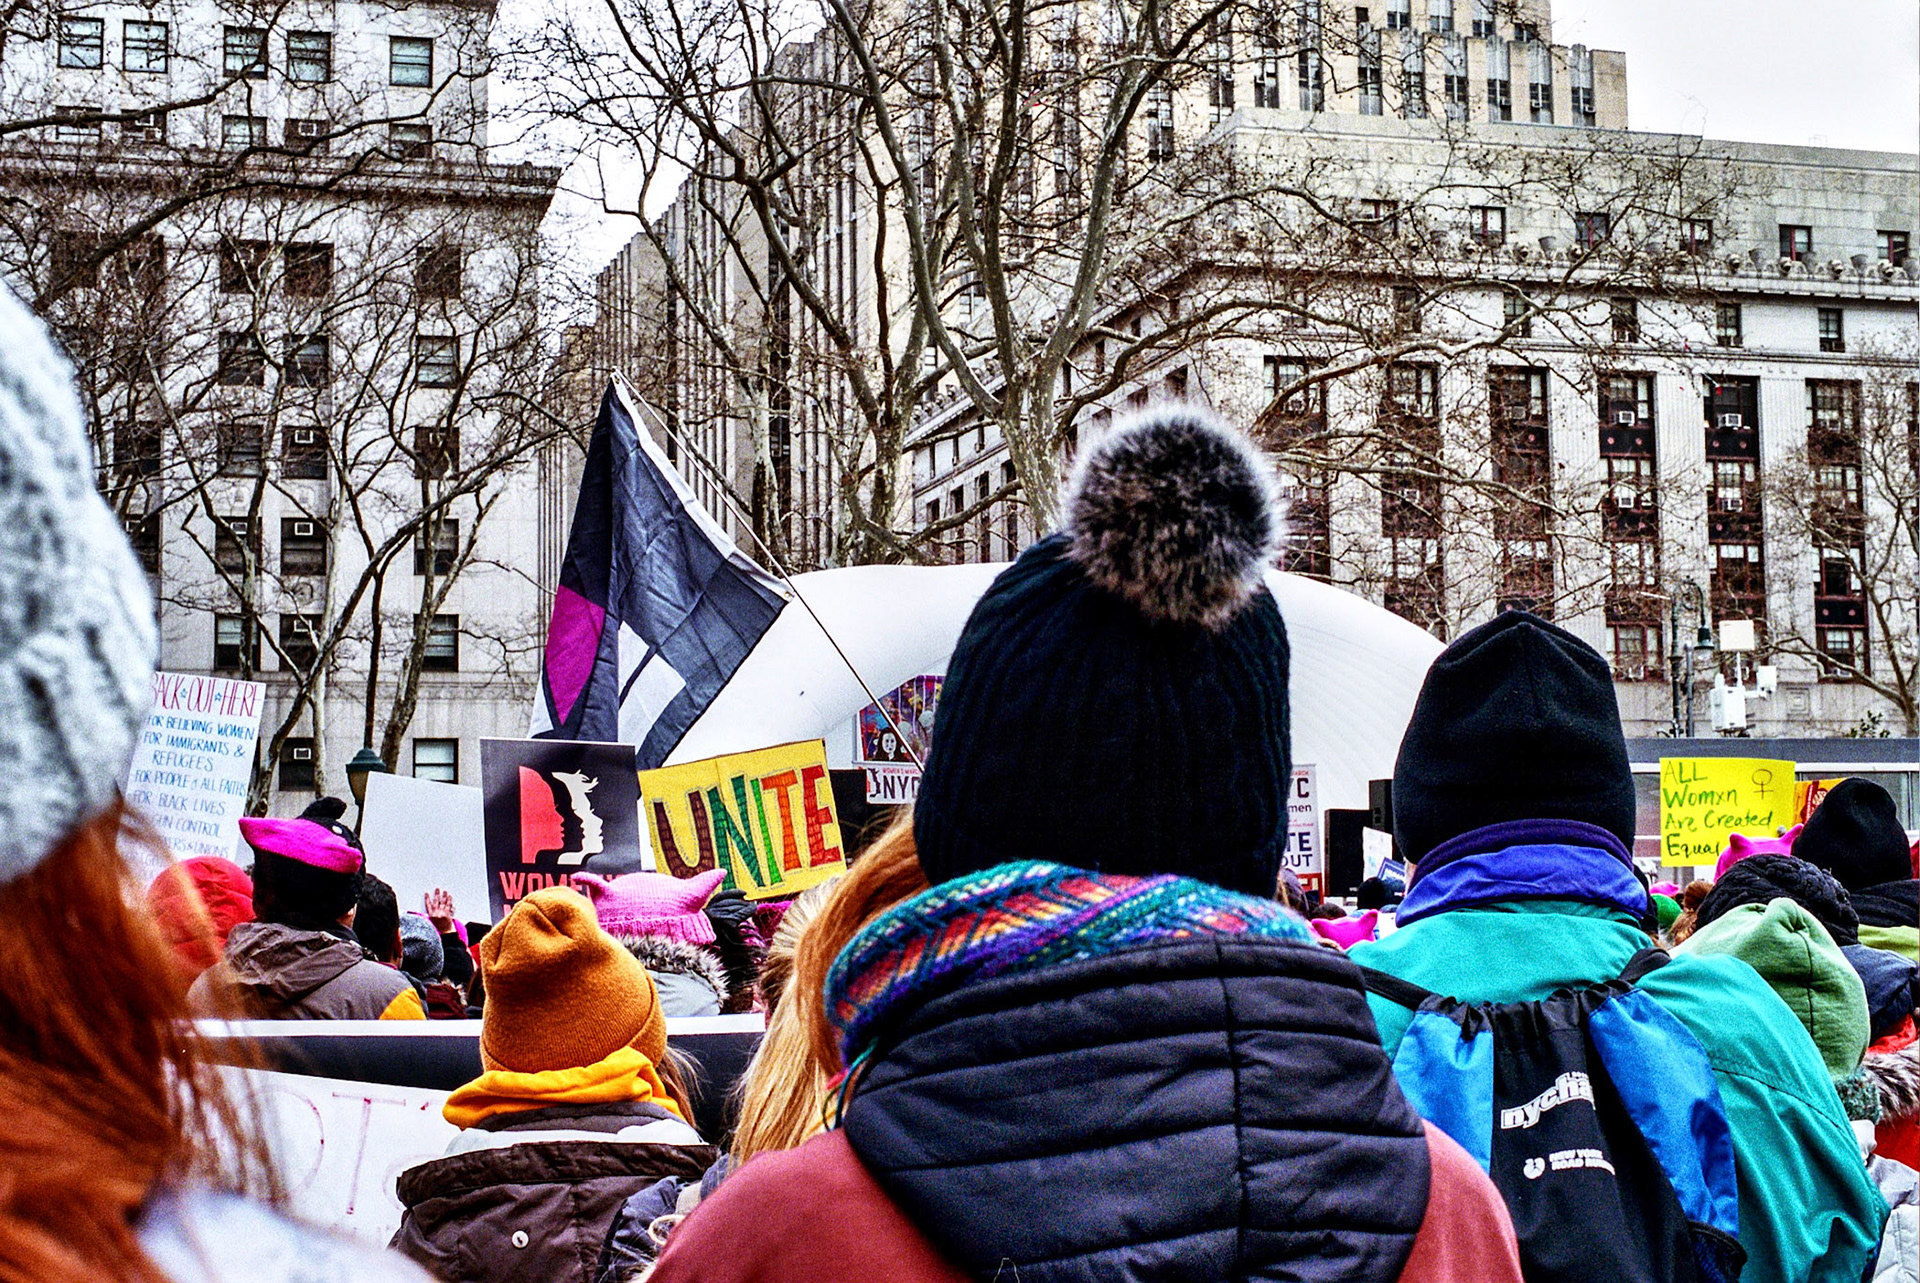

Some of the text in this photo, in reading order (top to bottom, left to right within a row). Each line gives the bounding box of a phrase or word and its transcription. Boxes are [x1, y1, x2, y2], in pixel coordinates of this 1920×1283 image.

[187, 677, 217, 713] OUT
[219, 681, 262, 718] HERE
[148, 714, 255, 740] FOR BELIEVING WOMEN
[143, 732, 245, 757] FOR IMMIGRANTS &
[152, 750, 214, 772] REFUGEES
[1663, 761, 1708, 785] ALL
[135, 769, 152, 783] FOR
[155, 770, 190, 788] PEOPLE
[200, 777, 216, 791] ALL
[220, 780, 247, 797] FAITHS
[882, 775, 921, 800] NYC
[133, 789, 226, 816] FOR BLACK LIVES
[1663, 784, 1738, 808] Womxn
[176, 818, 220, 838] CONTROL
[653, 764, 842, 891] UNITE
[1665, 809, 1773, 832] Are Created
[1666, 833, 1720, 859] Equal
